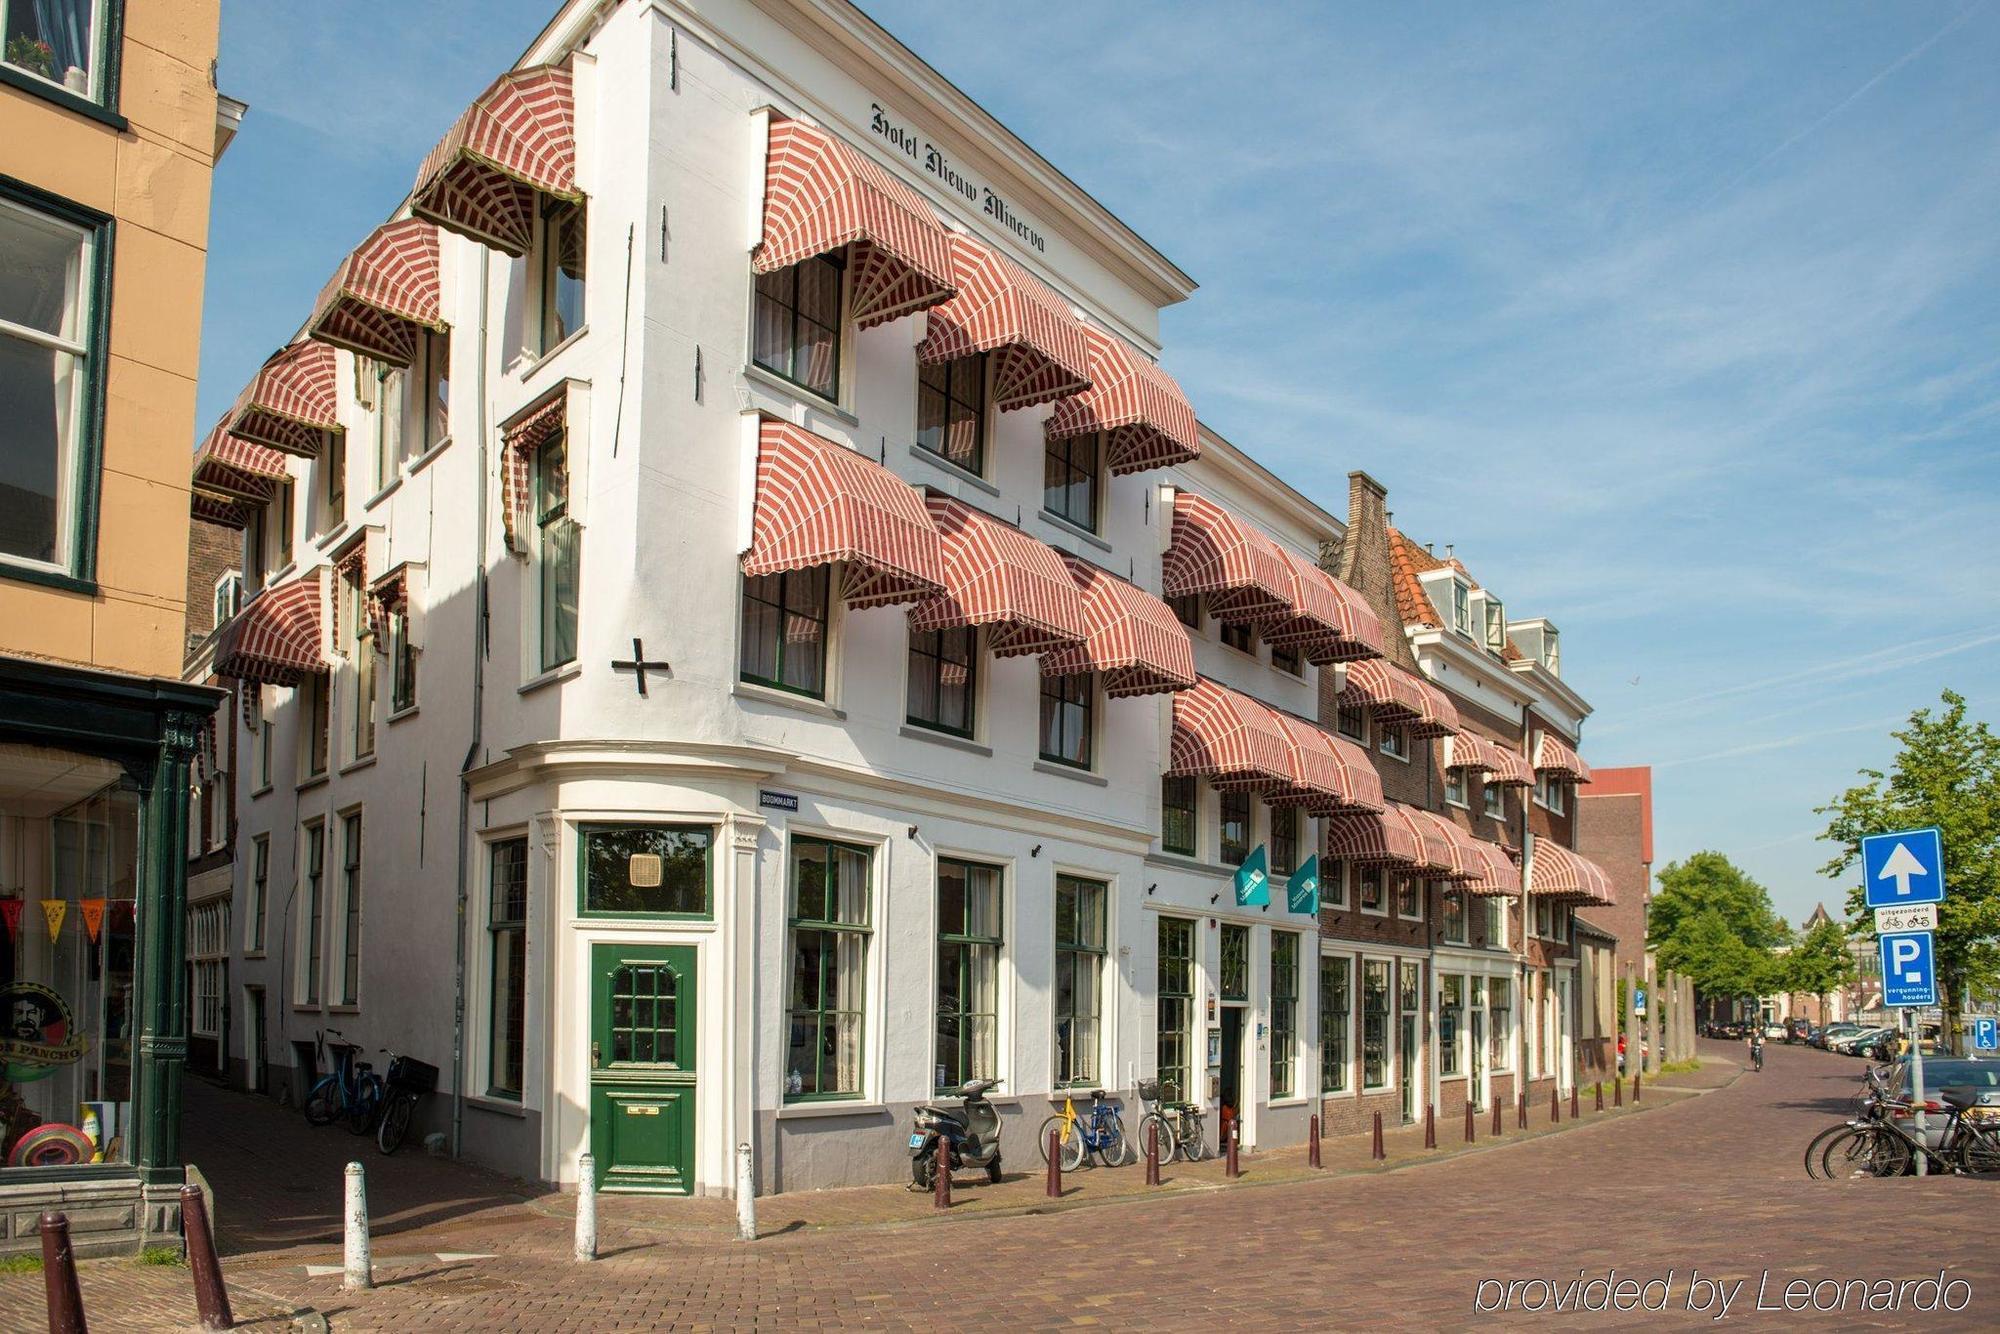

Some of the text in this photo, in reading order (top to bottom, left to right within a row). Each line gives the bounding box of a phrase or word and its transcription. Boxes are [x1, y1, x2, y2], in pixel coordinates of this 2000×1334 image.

[871, 102, 1045, 253] Hotel Nieuw Minerva
[1880, 907, 1929, 916] uitgezonderd
[1892, 939, 1921, 976] P
[1979, 1020, 1992, 1037] P
[18, 1043, 80, 1060] PANCHO
